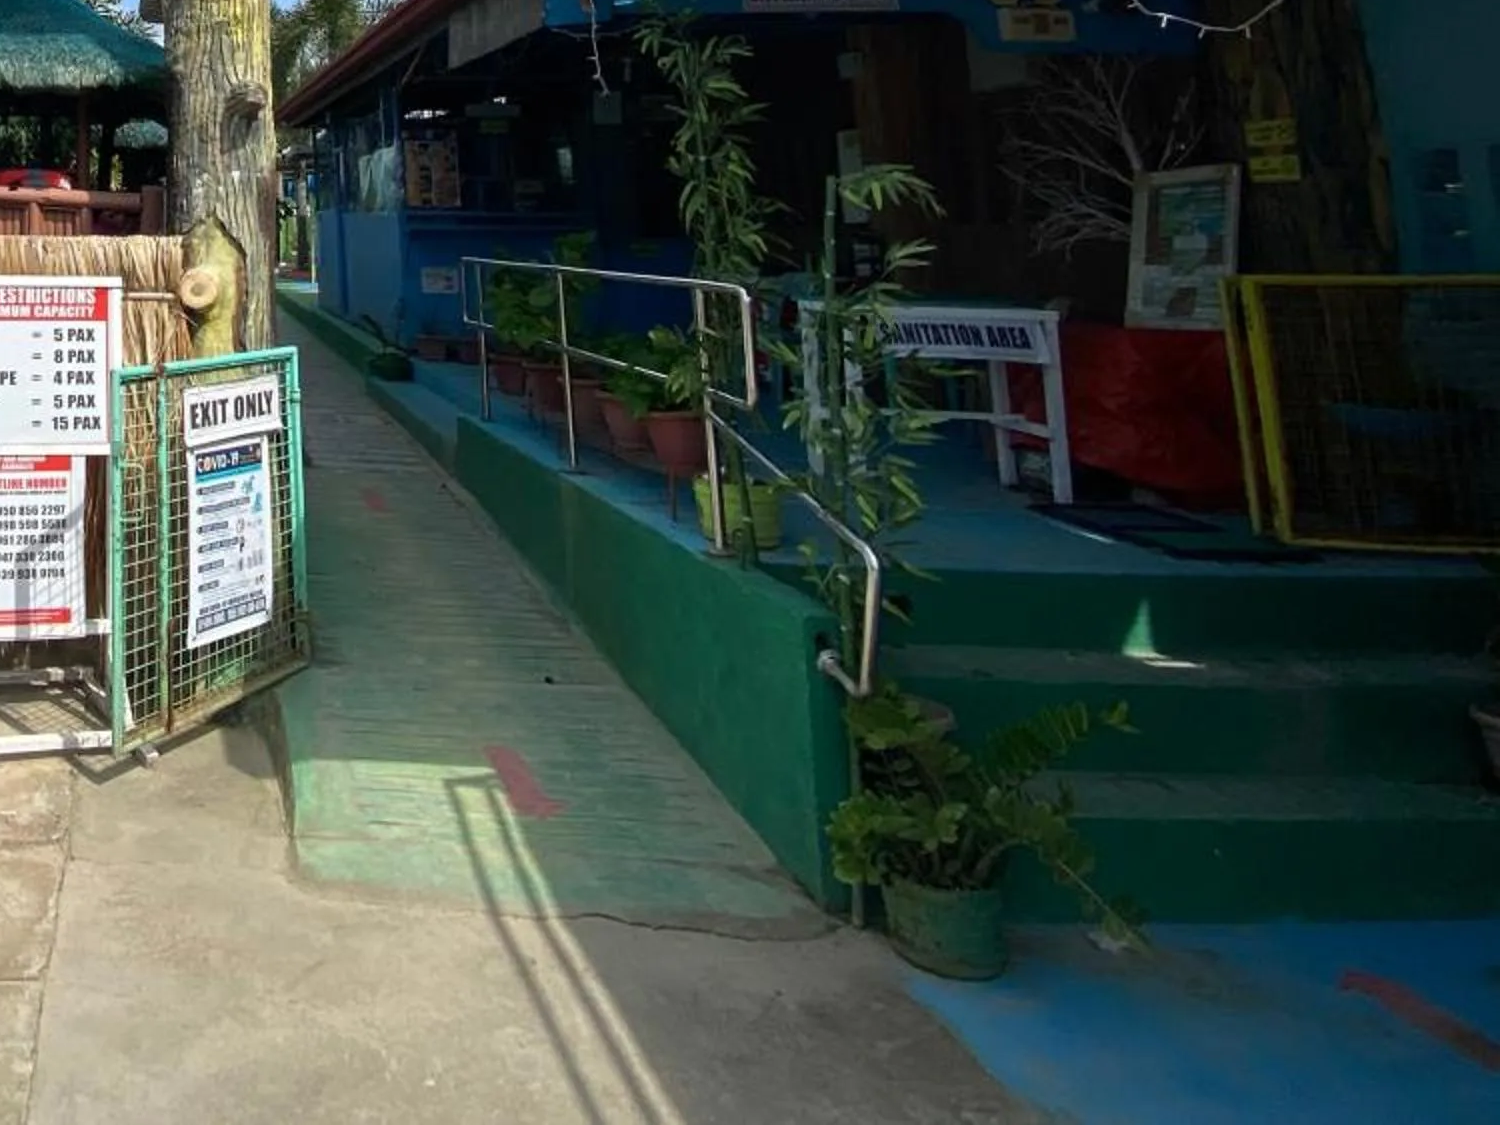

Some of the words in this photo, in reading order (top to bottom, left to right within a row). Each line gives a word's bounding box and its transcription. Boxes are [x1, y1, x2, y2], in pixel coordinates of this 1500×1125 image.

[33, 304, 96, 318] CAPACITY
[53, 328, 63, 342] 5
[67, 328, 96, 342] PAX
[879, 321, 985, 347] SANITATION
[985, 325, 1033, 350] AREA
[53, 349, 63, 363] 8
[67, 349, 96, 363] PAX
[53, 371, 63, 385] 4
[67, 371, 96, 385] PAX
[53, 394, 63, 409] 5
[67, 394, 96, 409] PAX
[189, 398, 229, 430] EXIT
[233, 390, 274, 422] ONLY
[51, 416, 69, 430] 15
[73, 416, 102, 430] PAX
